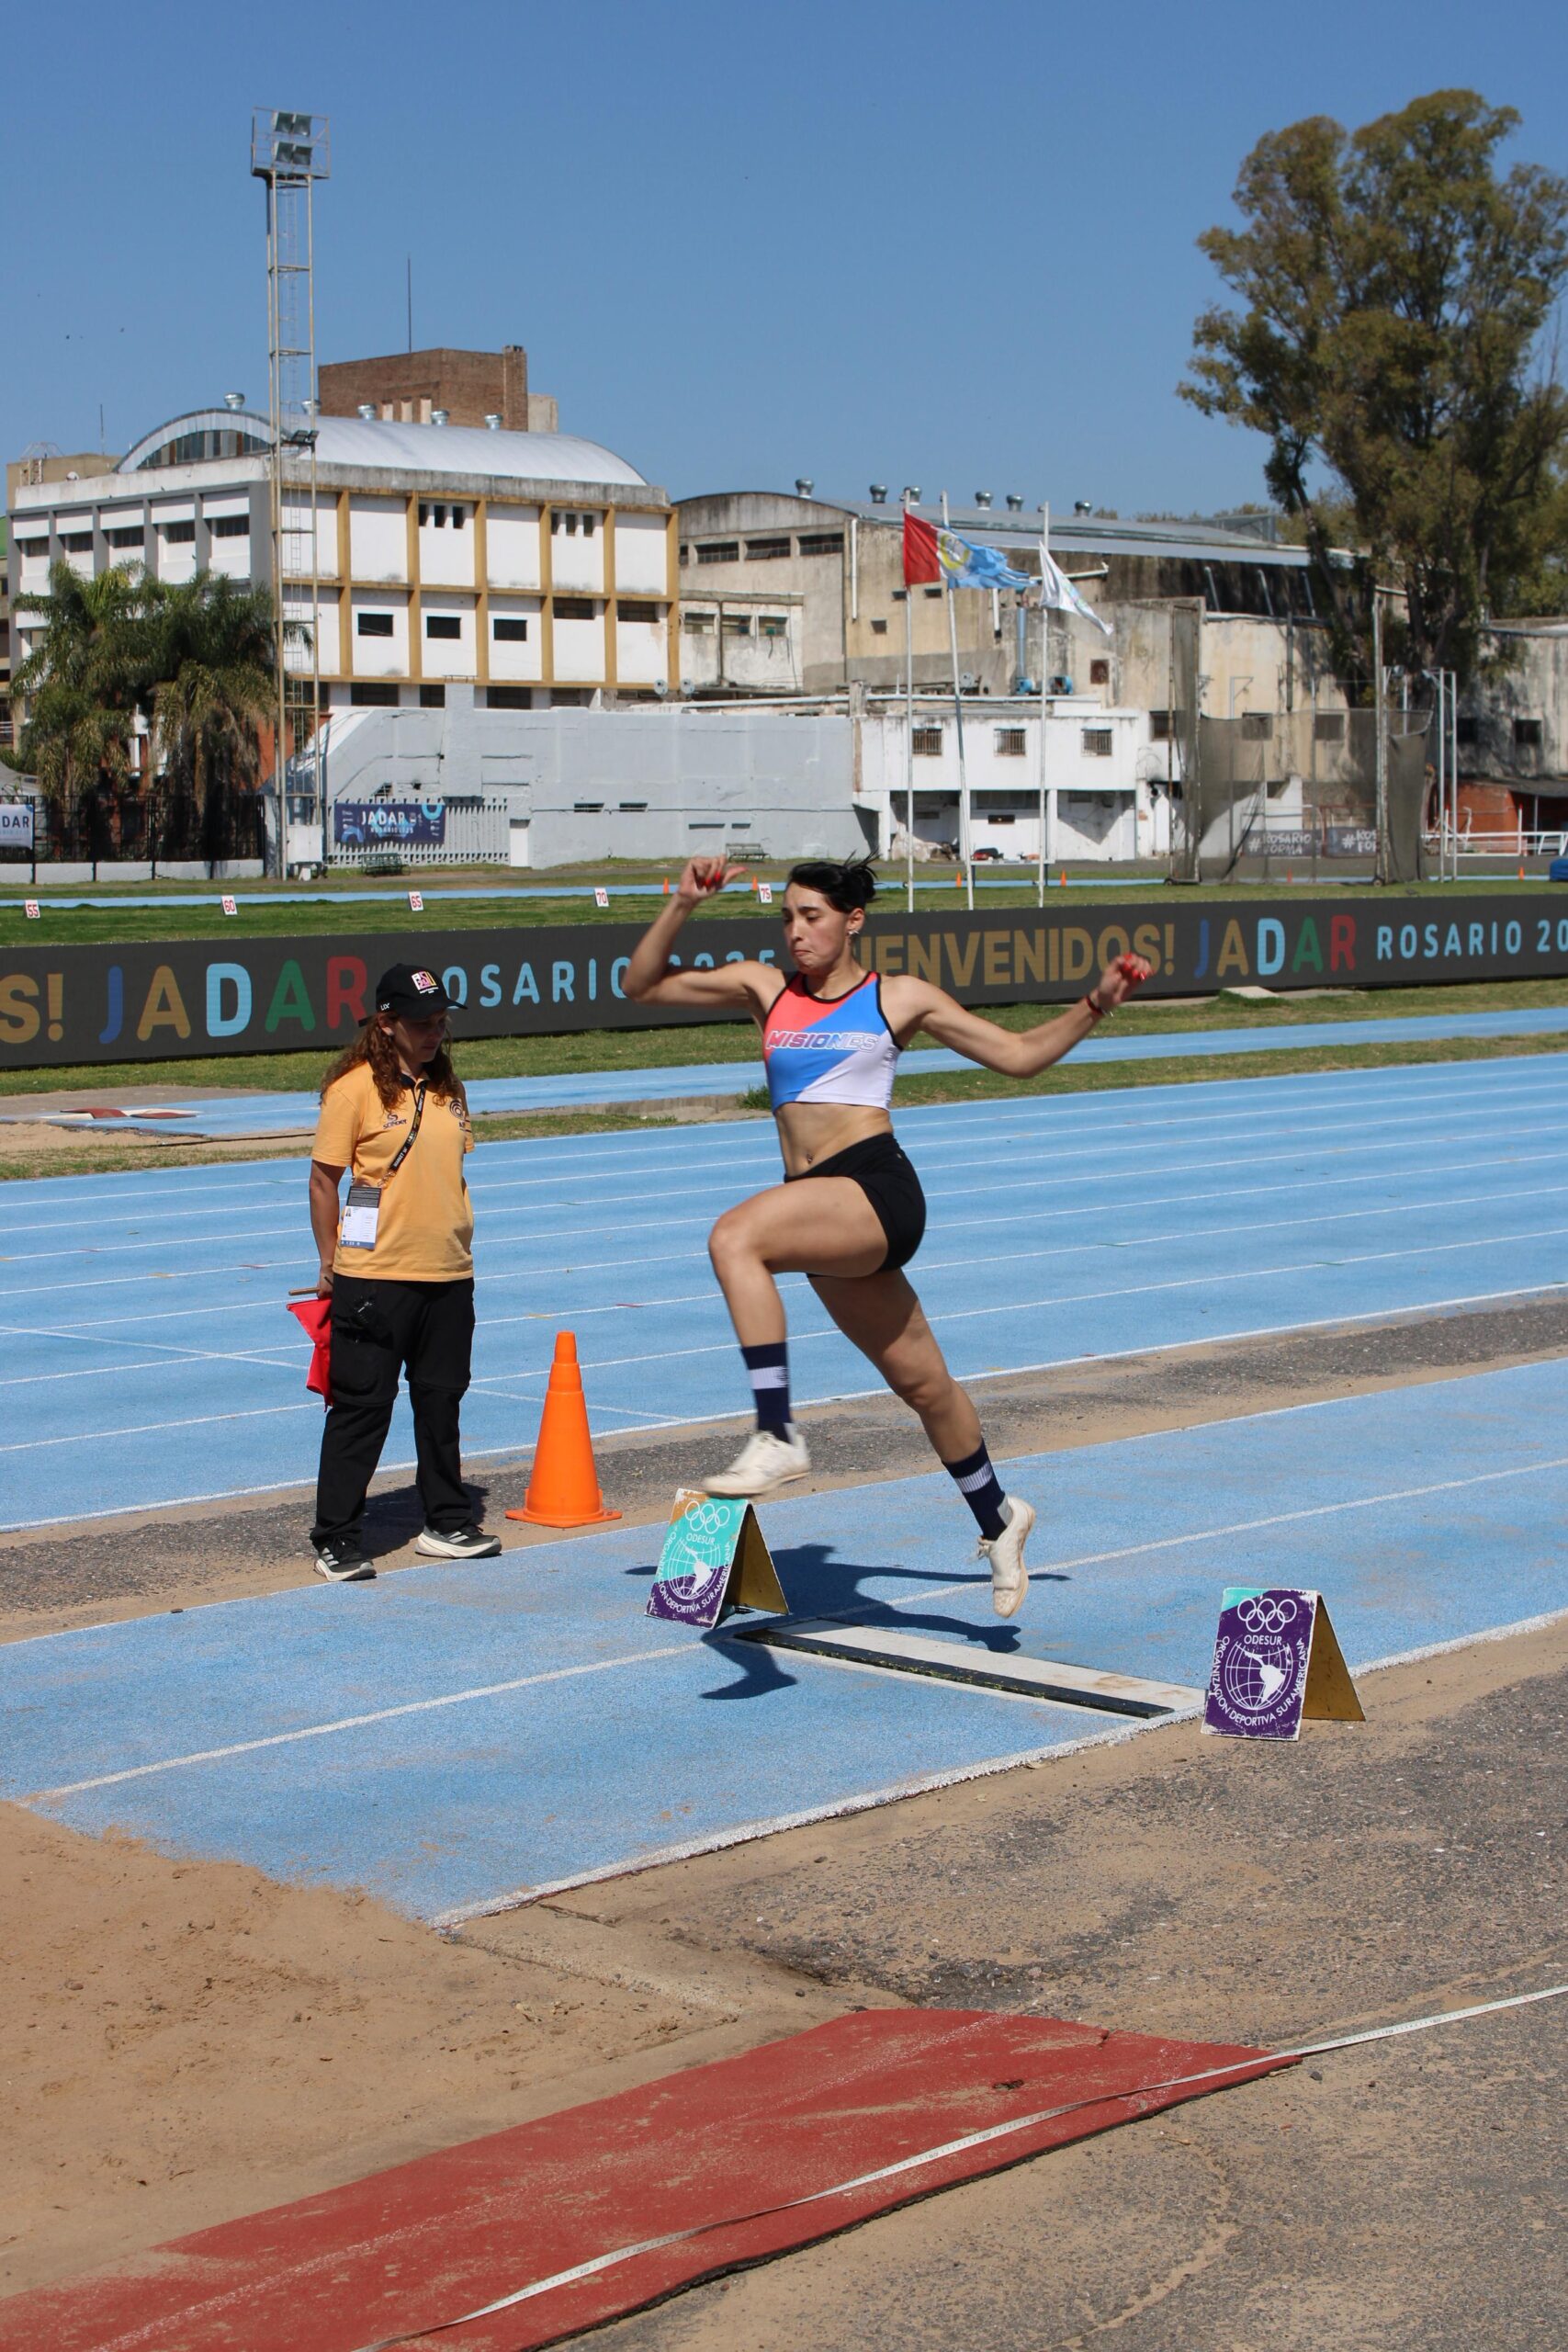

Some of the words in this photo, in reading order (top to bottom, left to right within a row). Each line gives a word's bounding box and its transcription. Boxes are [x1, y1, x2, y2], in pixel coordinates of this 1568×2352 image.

[2, 815, 29, 828] DAR
[361, 810, 407, 826] JADAR
[596, 892, 608, 904] 70
[761, 888, 772, 900] 75
[224, 899, 236, 912] 60
[411, 896, 423, 908] 65
[27, 904, 39, 918] 55
[0, 974, 63, 1044] S!
[98, 956, 367, 1044] JADAR
[442, 956, 632, 1009] OSARIO
[855, 923, 1175, 988] IENVENIDOS!
[1194, 915, 1356, 979] JADAR
[1377, 920, 1522, 960] ROSARIO
[765, 1030, 878, 1052] MISIONES
[686, 1532, 716, 1546] ODESUR
[1244, 1634, 1282, 1645] ODESUR
[1229, 1709, 1276, 1726] DEPORTIVA
[1276, 1637, 1307, 1716] SURAMERICANA
